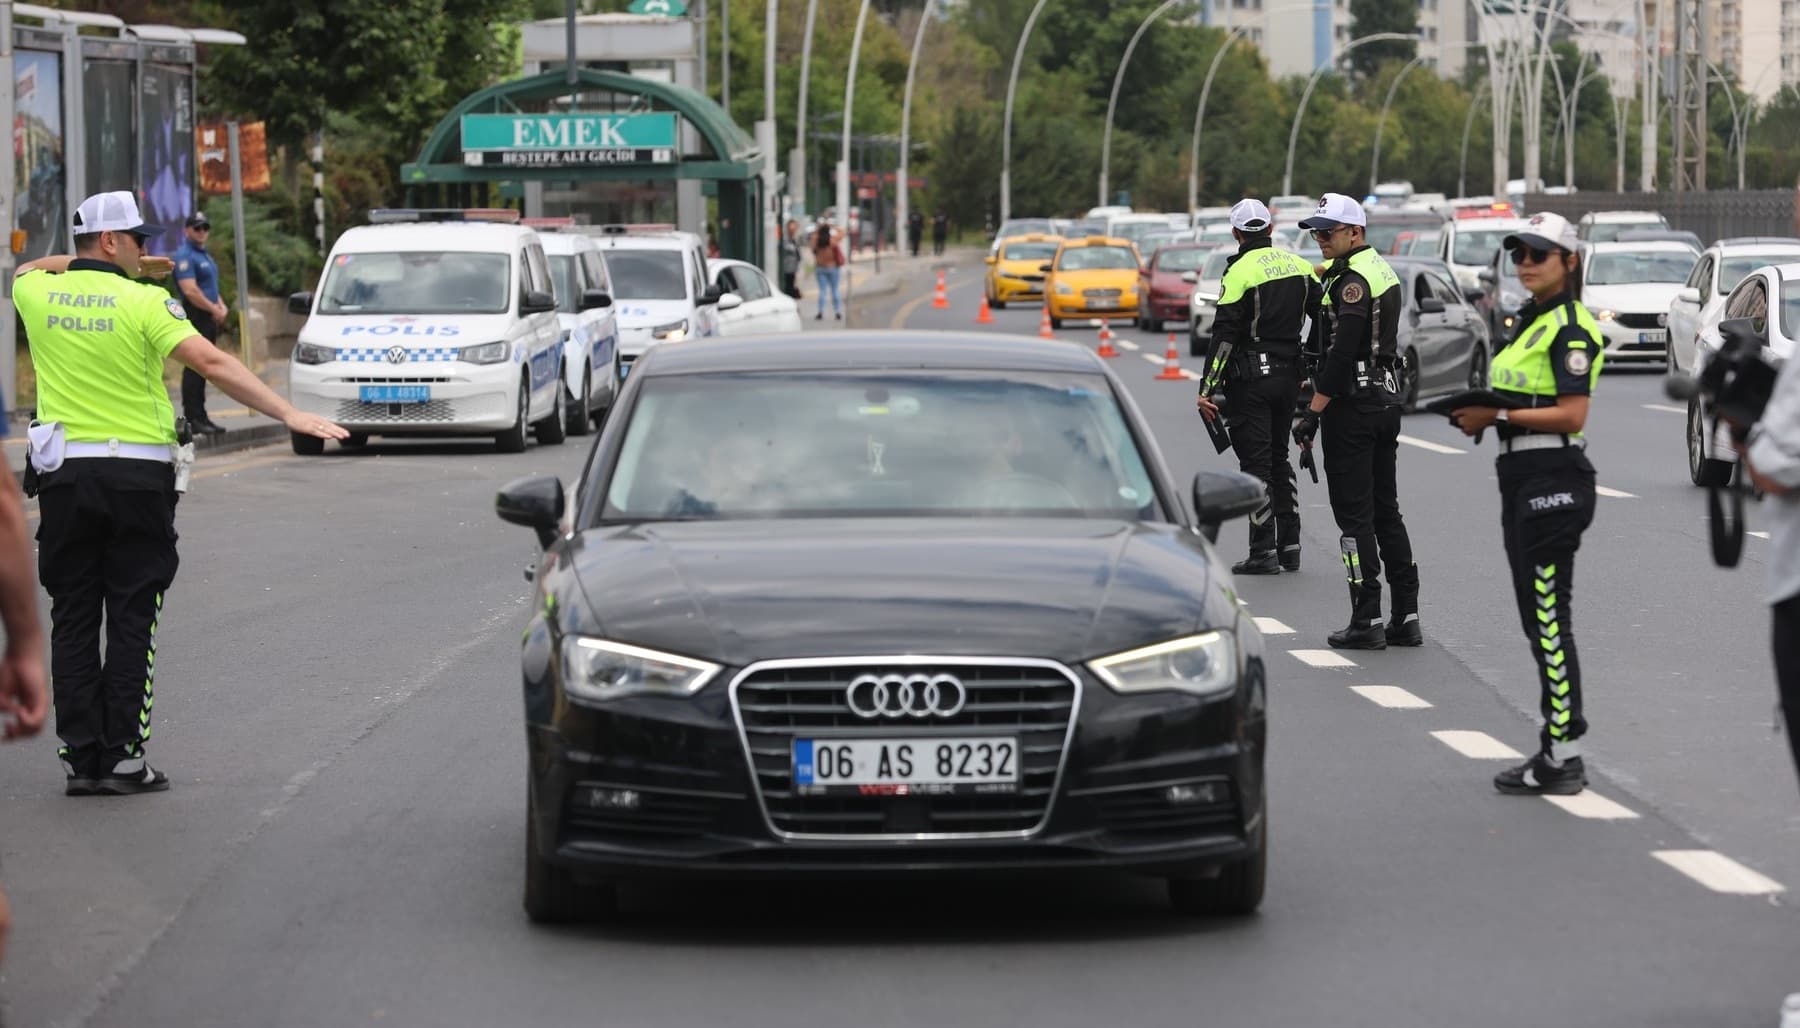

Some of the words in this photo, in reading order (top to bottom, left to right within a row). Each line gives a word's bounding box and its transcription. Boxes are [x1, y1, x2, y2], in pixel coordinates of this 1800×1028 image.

[513, 118, 628, 147] EMEK
[562, 151, 586, 162] ALT
[817, 746, 853, 779] 06
[877, 745, 914, 778] AS
[936, 743, 1013, 777] 8232
